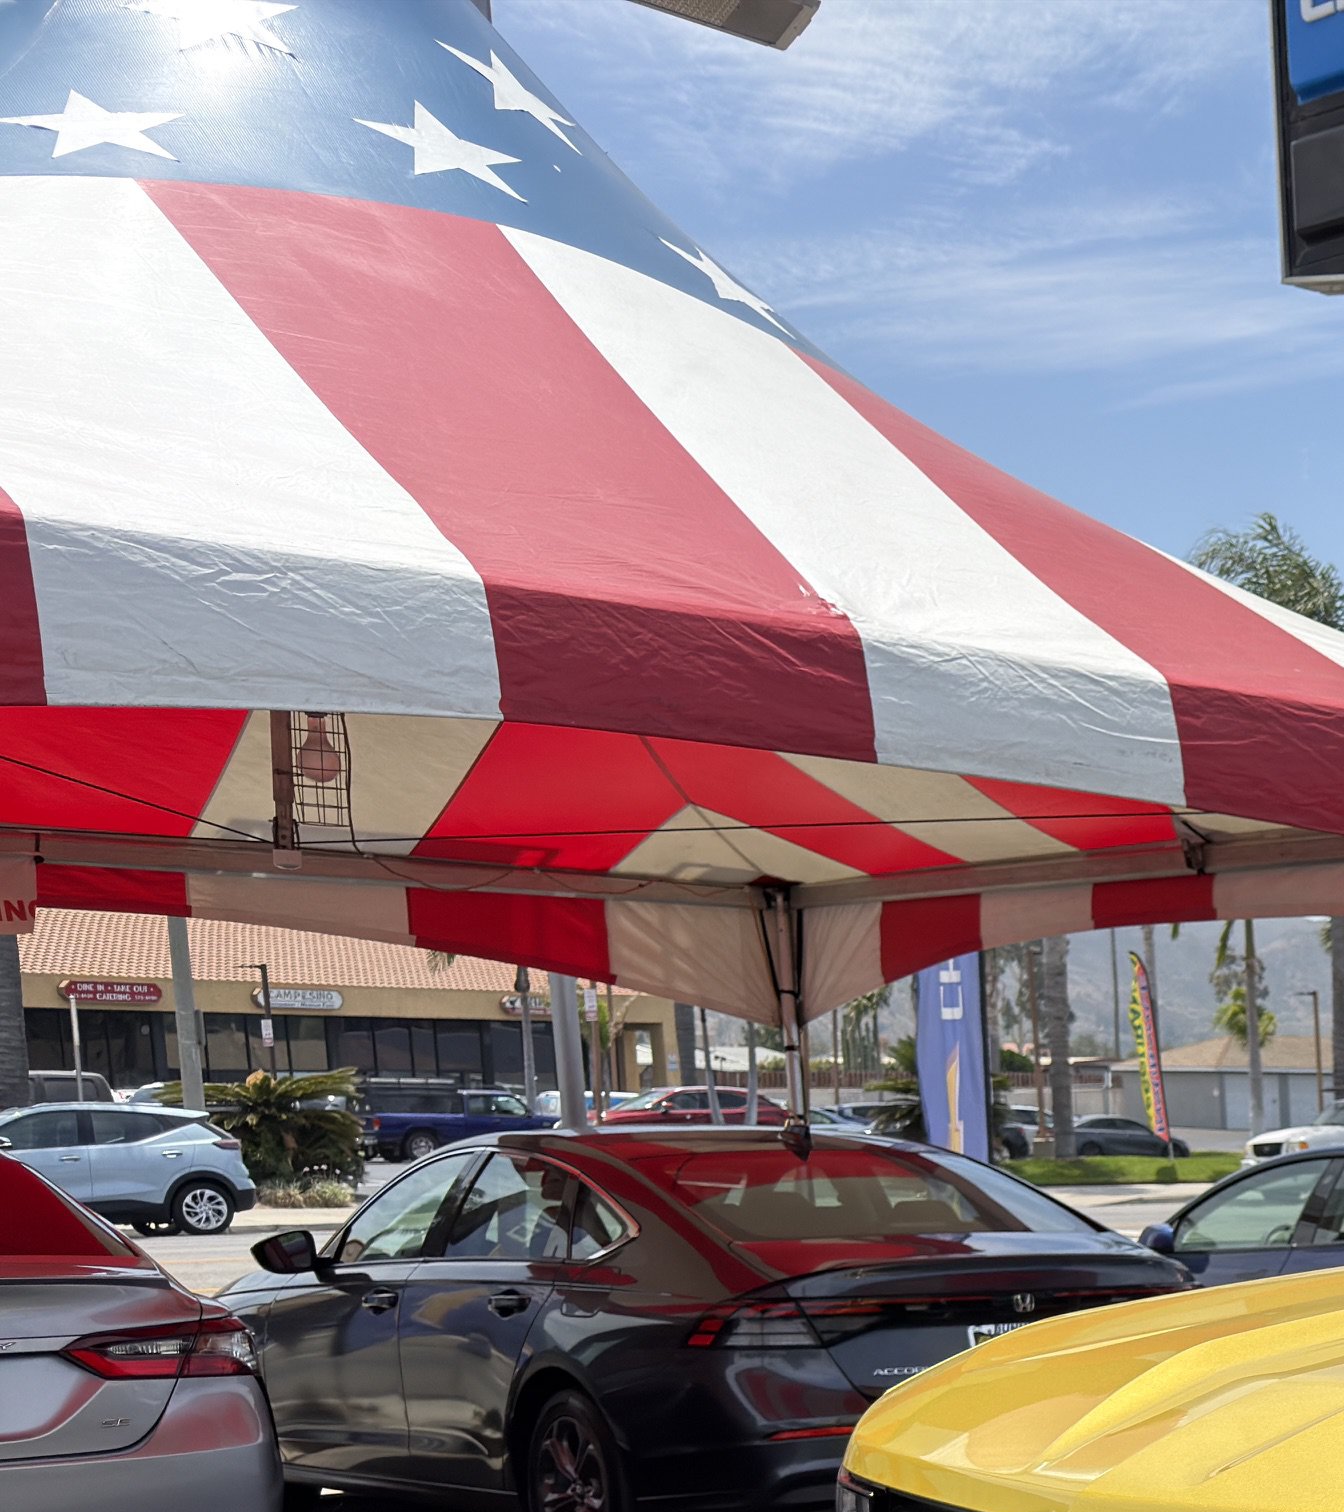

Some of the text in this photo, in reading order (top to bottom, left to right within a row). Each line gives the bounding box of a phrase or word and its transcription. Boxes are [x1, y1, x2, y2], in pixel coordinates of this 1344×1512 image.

[76, 983, 148, 993] DINE IN TAKE OUT
[96, 993, 131, 1001] CATERING
